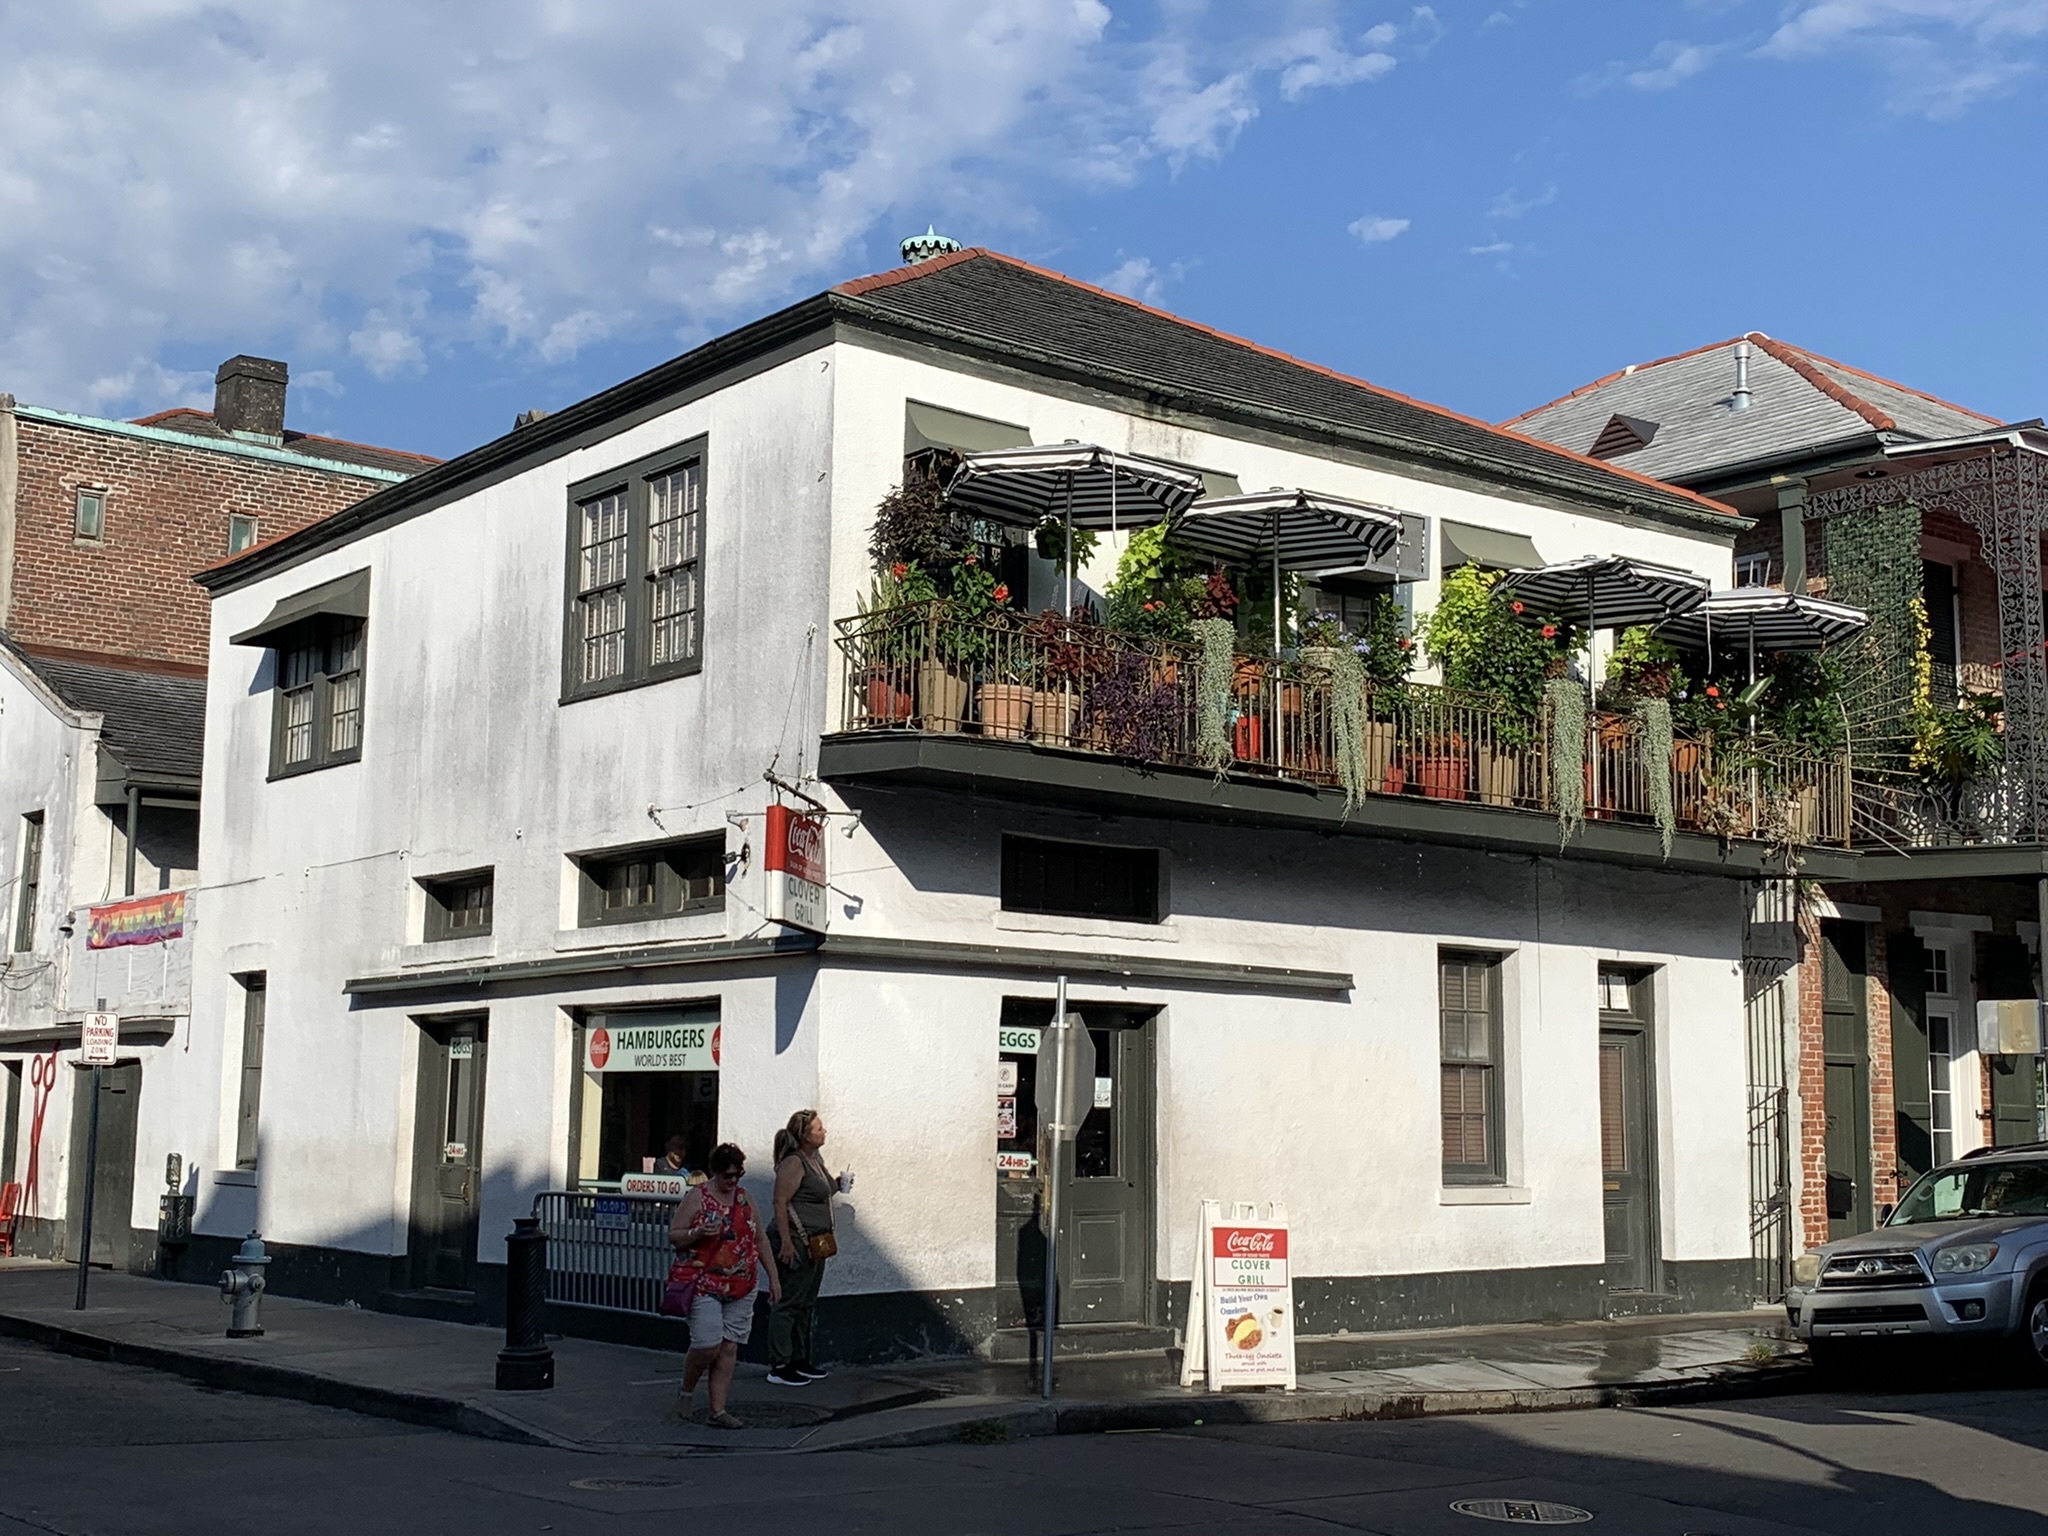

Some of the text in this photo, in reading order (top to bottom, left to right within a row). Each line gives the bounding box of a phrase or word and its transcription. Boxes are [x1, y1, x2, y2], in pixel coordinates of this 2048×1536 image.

[788, 876, 820, 905] CLOVER
[794, 902, 814, 926] GRILL
[94, 1015, 108, 1026] NO
[86, 1027, 114, 1037] PARKING
[86, 1038, 113, 1046] LOADING
[617, 1029, 705, 1050] HAMBURGERS
[999, 1031, 1036, 1048] EGGS
[90, 1046, 107, 1054] ZONE
[634, 1053, 687, 1067] WORLD'S BEST
[626, 1179, 680, 1194] ORDERS TO GO
[1226, 1230, 1275, 1252] Coca-Cola
[1231, 1259, 1271, 1270] CLOVER
[1237, 1274, 1265, 1285] GRILL
[1220, 1292, 1268, 1304] Build Your Own
[1220, 1306, 1248, 1316] Omelette
